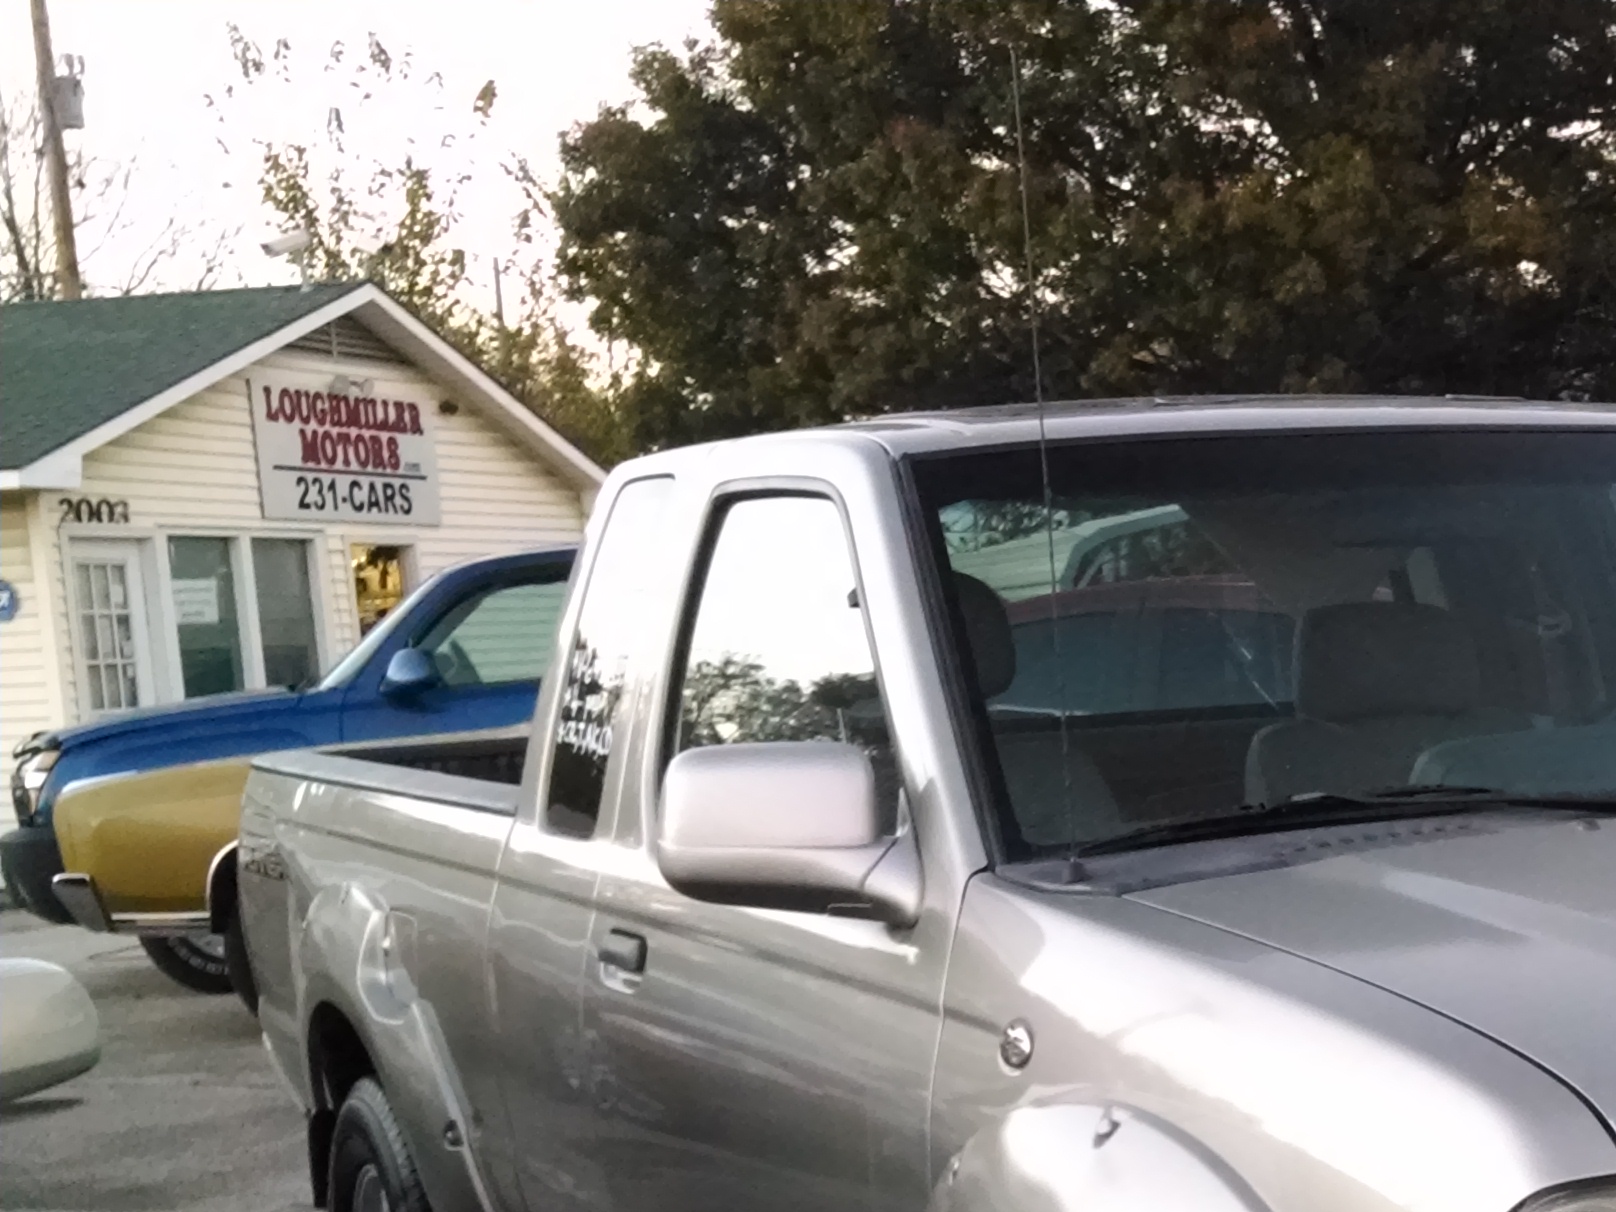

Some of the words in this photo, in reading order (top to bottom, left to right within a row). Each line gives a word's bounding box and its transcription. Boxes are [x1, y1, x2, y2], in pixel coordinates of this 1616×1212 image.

[263, 385, 424, 436] LOUGHMILLER
[299, 428, 401, 471] MOTORS
[296, 476, 413, 516] 231-CARS
